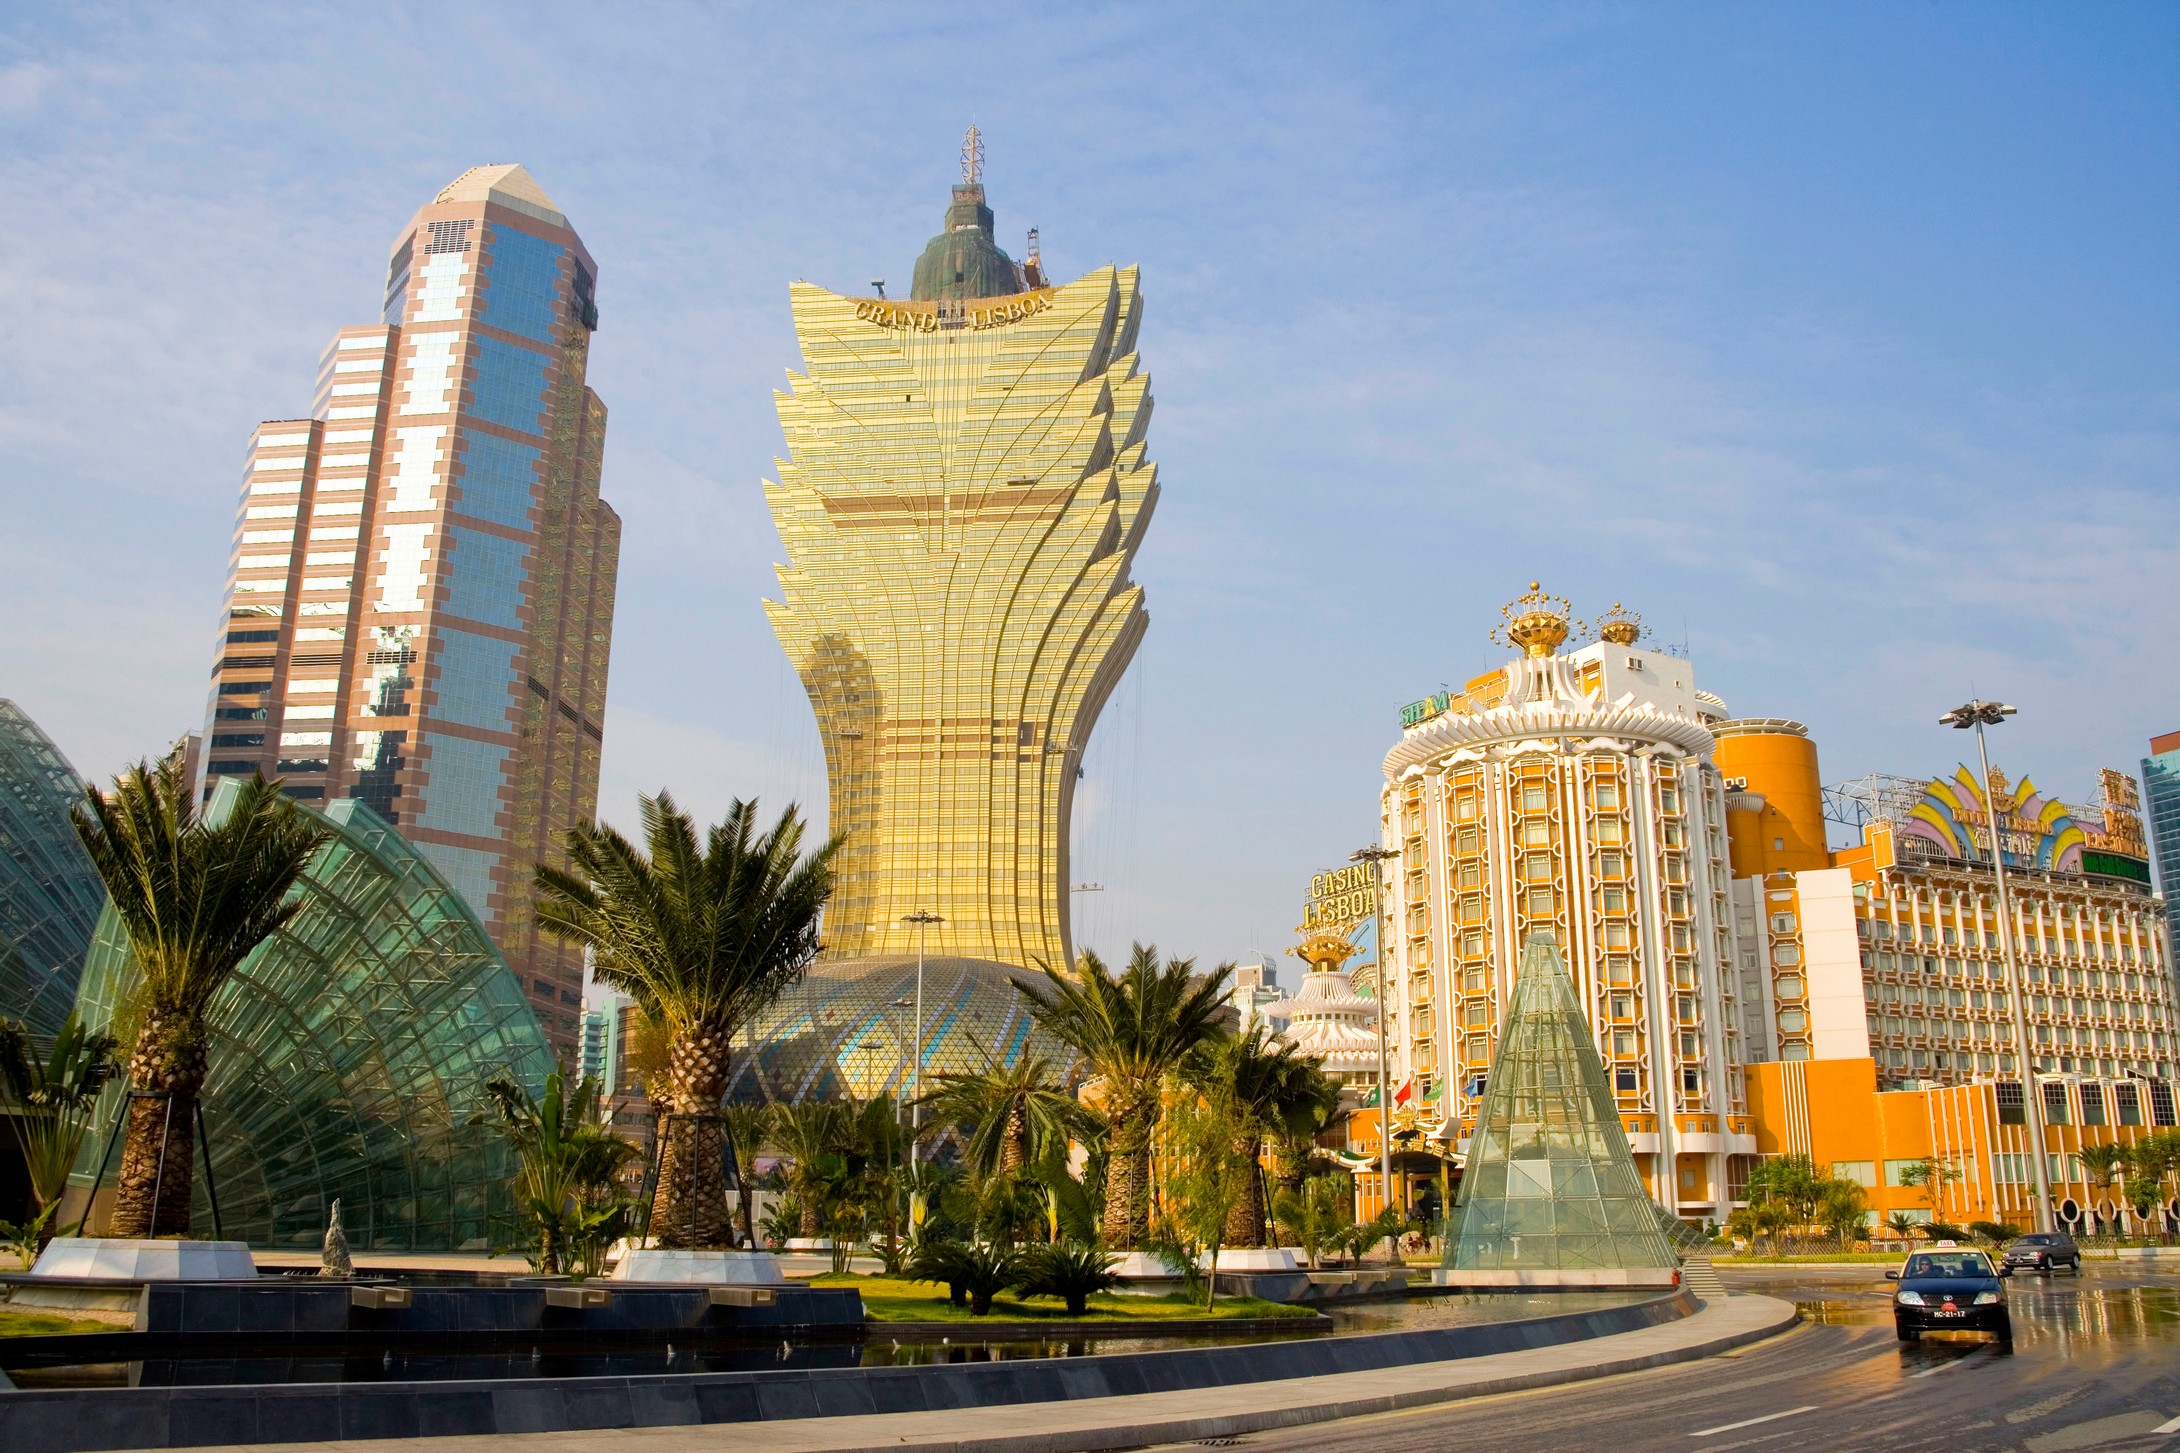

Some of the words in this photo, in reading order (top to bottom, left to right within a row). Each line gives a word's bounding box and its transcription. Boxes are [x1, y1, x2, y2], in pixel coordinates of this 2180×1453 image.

[854, 301, 938, 332] GRAND
[969, 294, 1054, 331] LISBOA
[1399, 690, 1449, 727] STEAM
[1952, 806, 1991, 827] HOTE
[1311, 860, 1375, 899] CASINO
[1303, 887, 1376, 929] LISBOA
